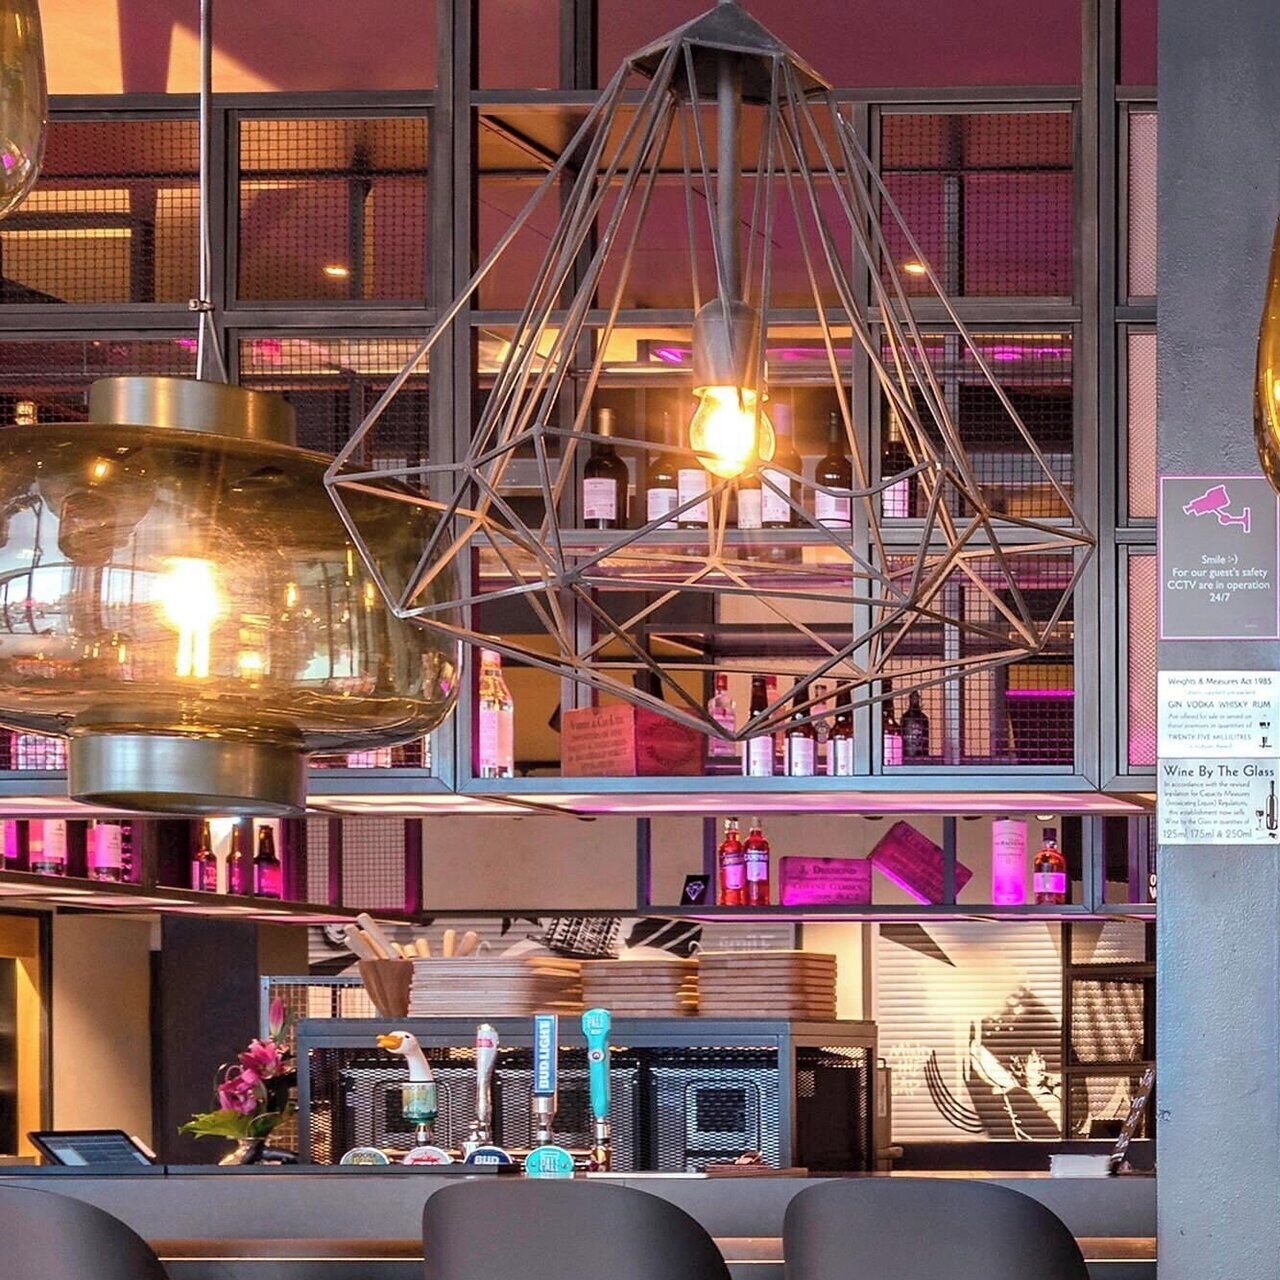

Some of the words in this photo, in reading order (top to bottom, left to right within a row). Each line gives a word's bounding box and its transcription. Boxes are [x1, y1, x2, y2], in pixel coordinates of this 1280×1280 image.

[1201, 554, 1226, 564] Smile
[1172, 568, 1189, 577] For
[1191, 569, 1206, 577] our
[1209, 568, 1240, 579] guest's
[1242, 568, 1268, 579] safety
[1167, 580, 1197, 590] CCTV
[1198, 581, 1213, 590] are
[1215, 580, 1225, 590] in
[1226, 580, 1271, 592] operation
[1209, 593, 1231, 602] 24/7
[1240, 677, 1253, 686] Act
[1167, 700, 1183, 709] GIN
[1186, 700, 1215, 709] VODKA
[1219, 700, 1248, 709] WHISKY
[1252, 700, 1272, 709] RUM
[1163, 764, 1195, 777] Wine
[1199, 764, 1214, 779] By
[1217, 764, 1239, 777] The
[1243, 764, 1275, 777] Glass
[538, 1020, 550, 1060] LIGHT
[538, 1063, 550, 1089] BUD
[473, 1155, 500, 1164] BUD
